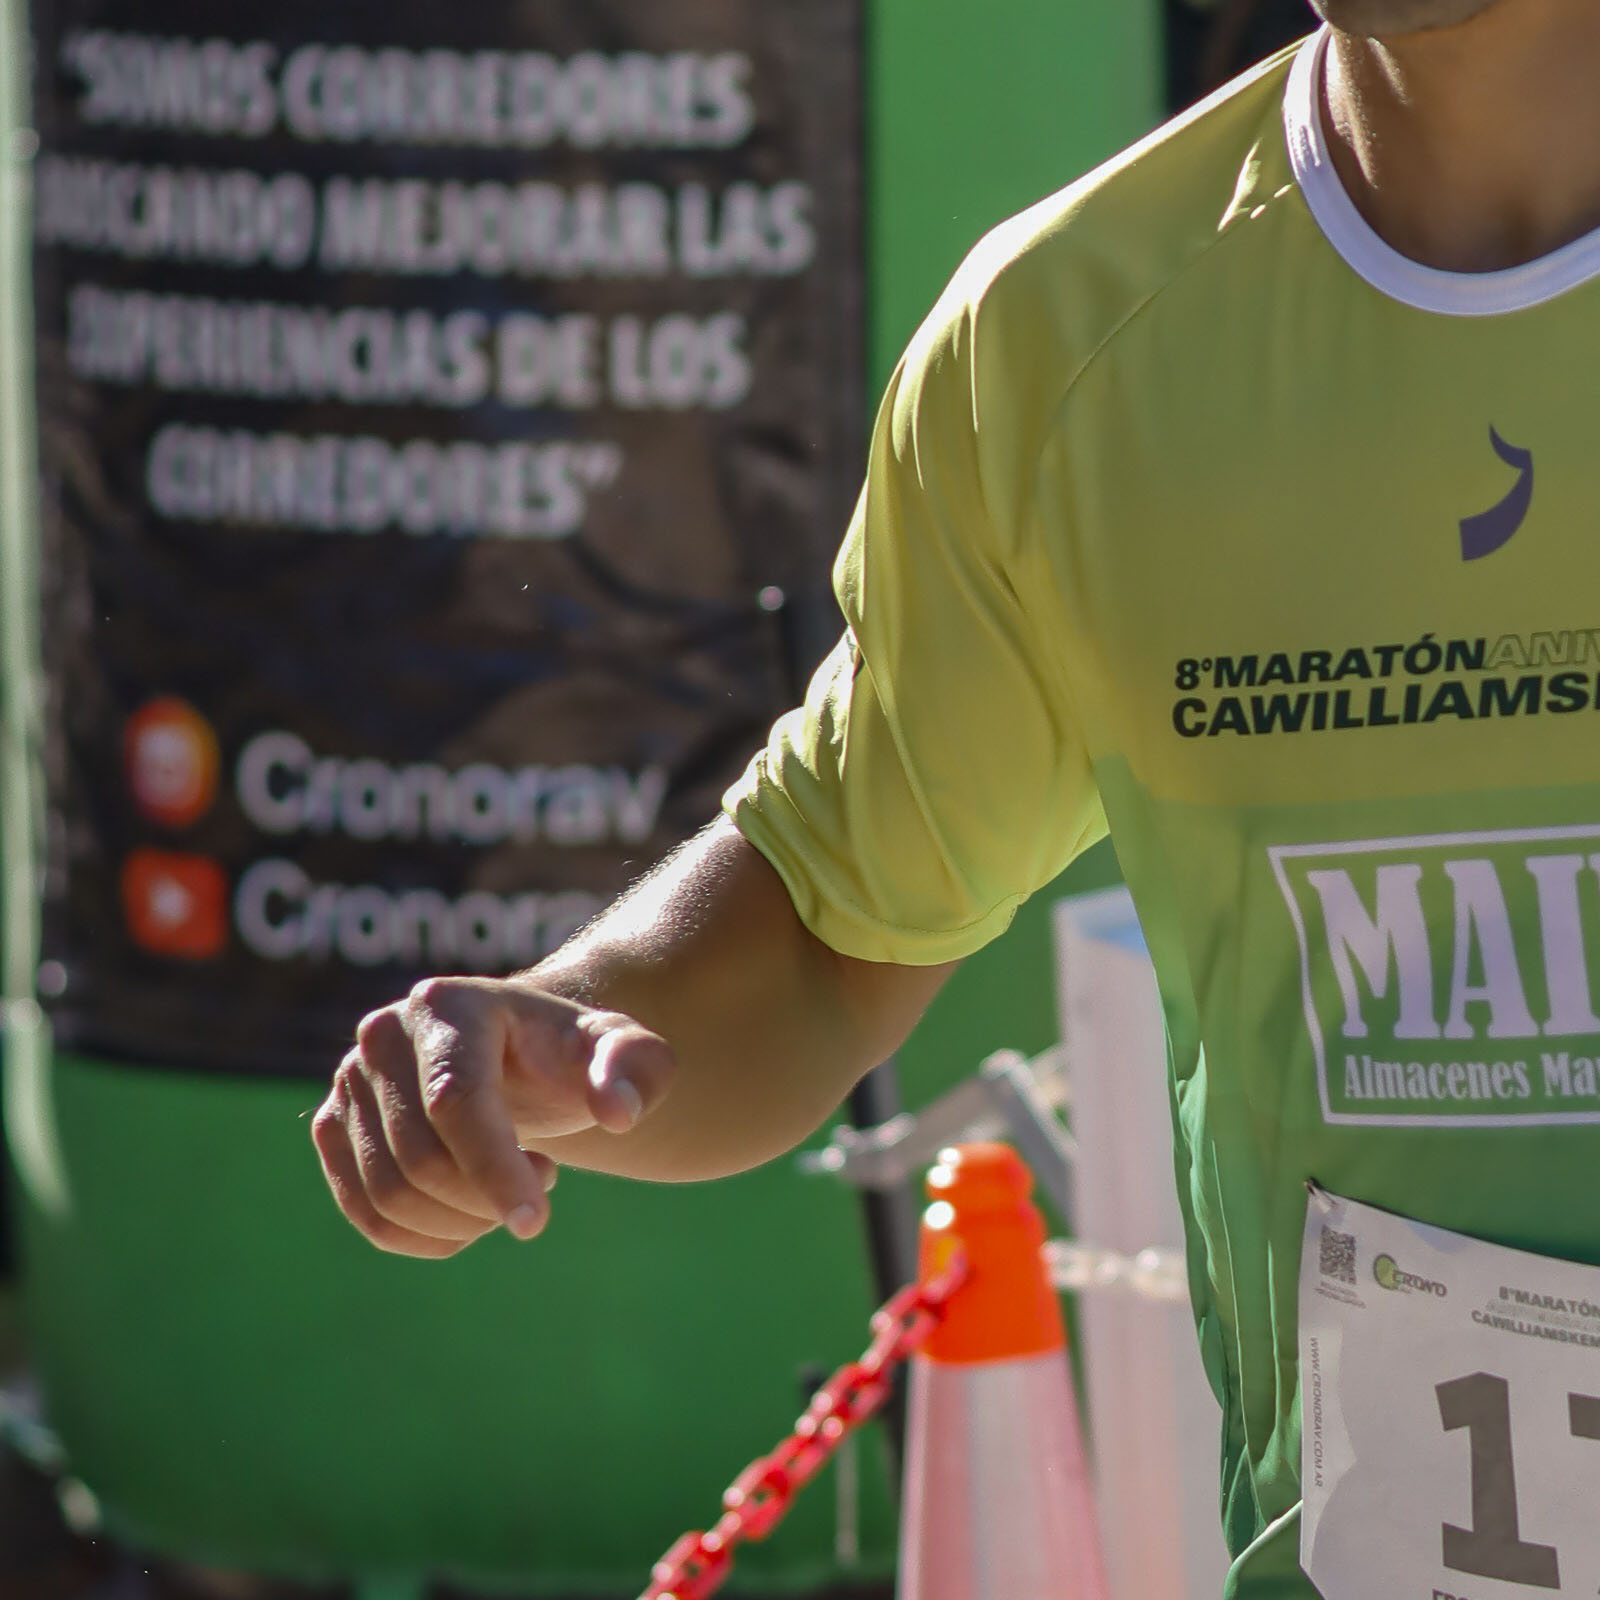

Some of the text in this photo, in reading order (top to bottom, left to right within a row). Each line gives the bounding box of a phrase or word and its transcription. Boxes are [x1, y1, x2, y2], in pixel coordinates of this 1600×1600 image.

[284, 43, 754, 147] CORREDORES
[322, 178, 670, 279] MEJORAR
[678, 180, 815, 276] LAS
[500, 310, 602, 406] DE
[610, 310, 752, 409] LOS
[235, 731, 666, 844] Cronorav
[233, 857, 602, 967] Cronora
[1343, 1053, 1530, 1100] Almacenes
